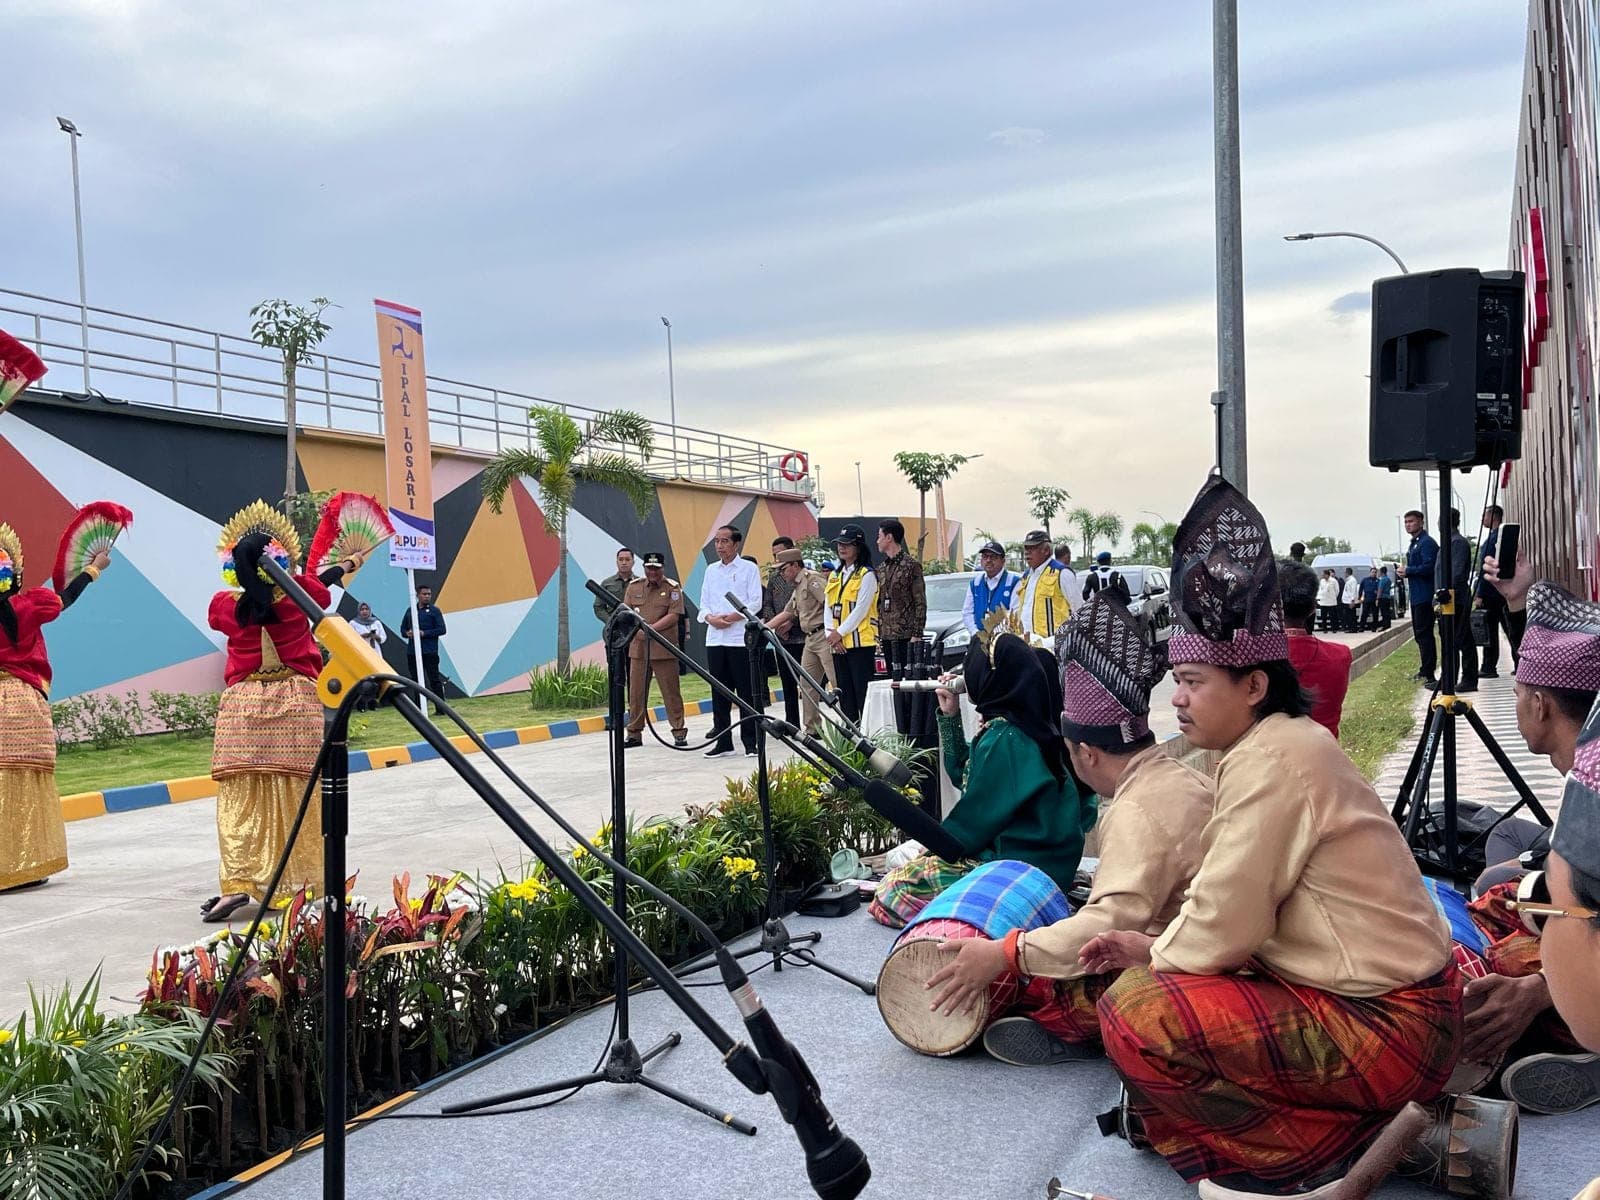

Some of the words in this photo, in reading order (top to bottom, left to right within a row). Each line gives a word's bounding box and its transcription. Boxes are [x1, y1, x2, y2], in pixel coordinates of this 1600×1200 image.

[401, 363, 411, 417] IPAL
[404, 427, 416, 510] LOSARI
[403, 535, 429, 549] PUPR
